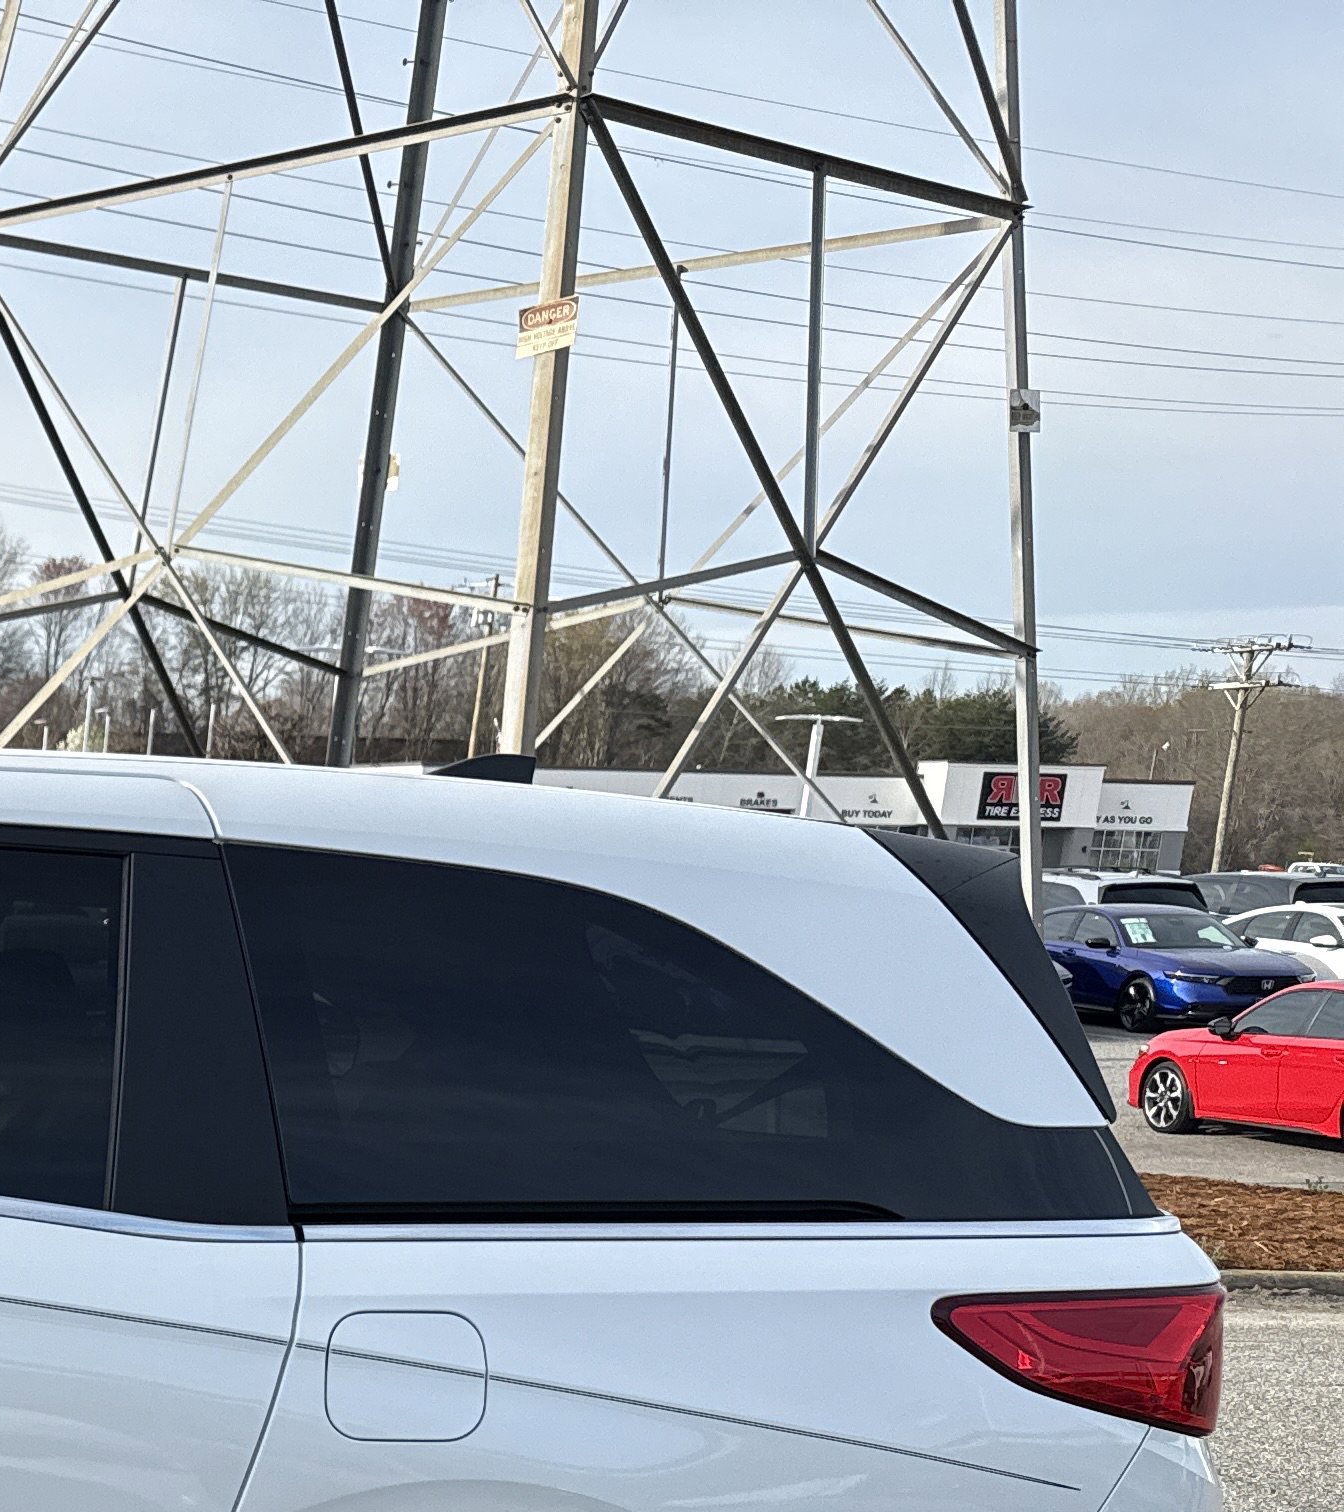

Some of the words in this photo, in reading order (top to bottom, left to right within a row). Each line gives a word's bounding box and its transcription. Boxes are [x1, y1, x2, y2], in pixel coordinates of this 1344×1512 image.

[527, 305, 570, 325] DANGER
[740, 798, 777, 807] BRAKES
[842, 809, 859, 818] BUY
[863, 809, 893, 818] TODAY
[985, 806, 1009, 816] TIRE
[1010, 806, 1060, 818] EESS
[1103, 815, 1115, 823] AS
[1118, 816, 1137, 824] YOU
